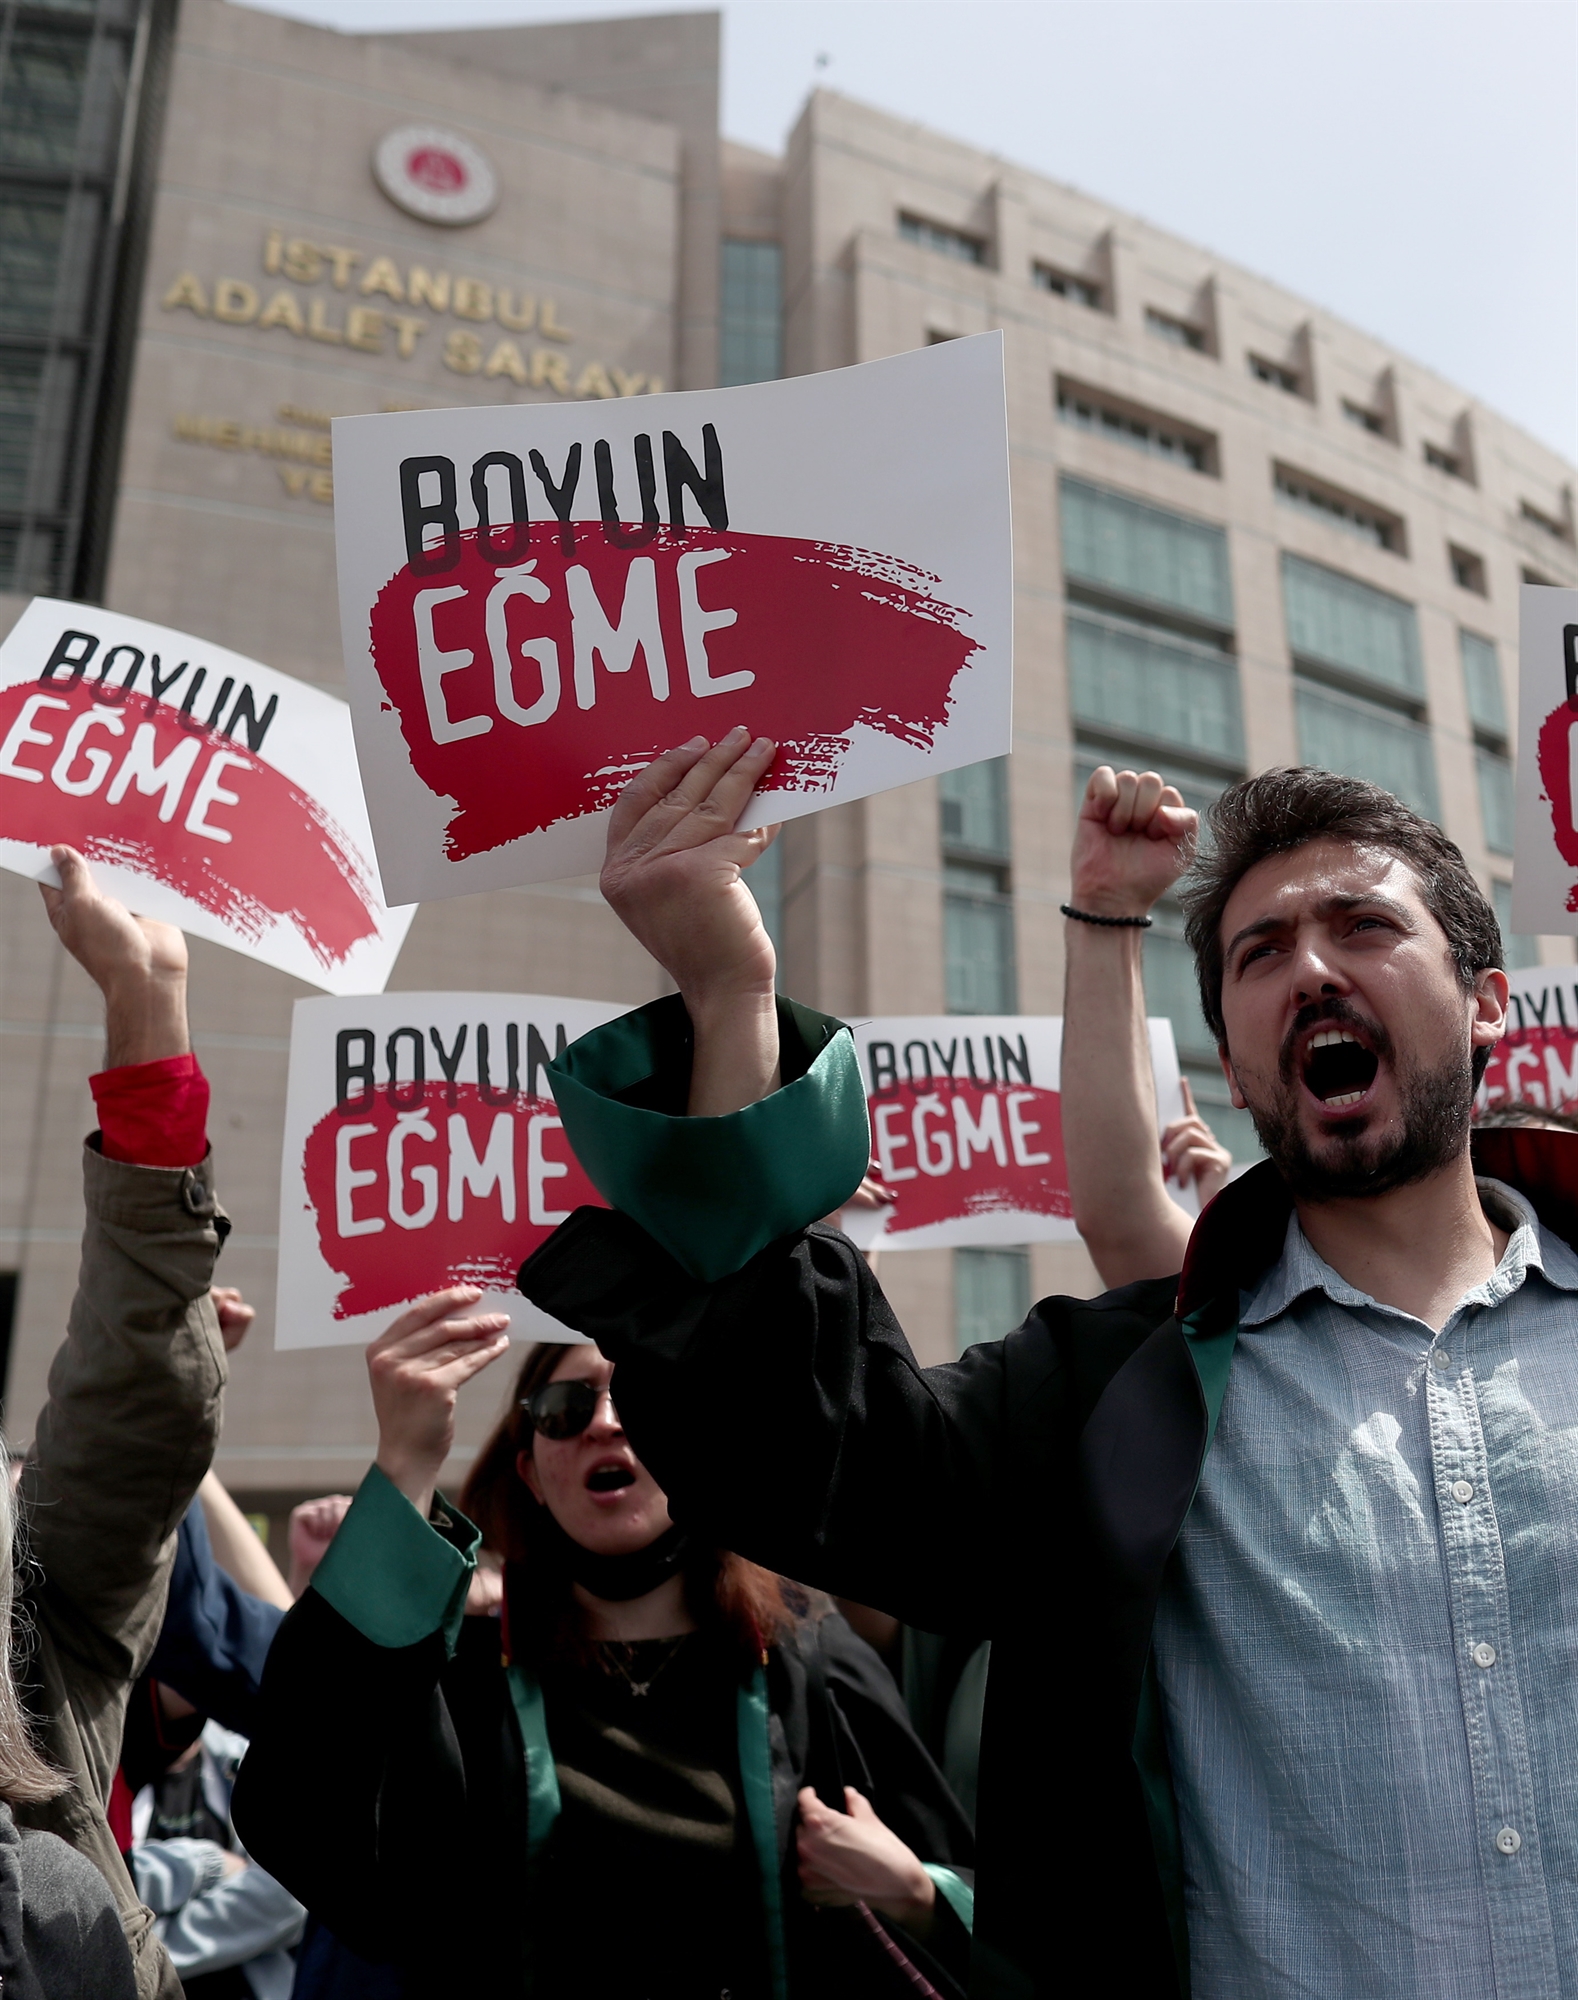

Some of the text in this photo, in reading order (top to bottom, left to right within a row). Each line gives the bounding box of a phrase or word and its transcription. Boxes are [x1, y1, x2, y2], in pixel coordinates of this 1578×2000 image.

[163, 271, 427, 358] ADALET
[265, 227, 572, 341] İSTANBUL
[399, 422, 729, 577] BOYUN
[38, 630, 279, 753] BOYUN
[412, 548, 756, 745] EĞME
[0, 693, 254, 844] EĞME
[336, 1022, 568, 1117] BOYUN
[867, 1033, 1032, 1099] BOYUN
[335, 1106, 572, 1238] EĞME
[874, 1091, 1051, 1183] EĞME
